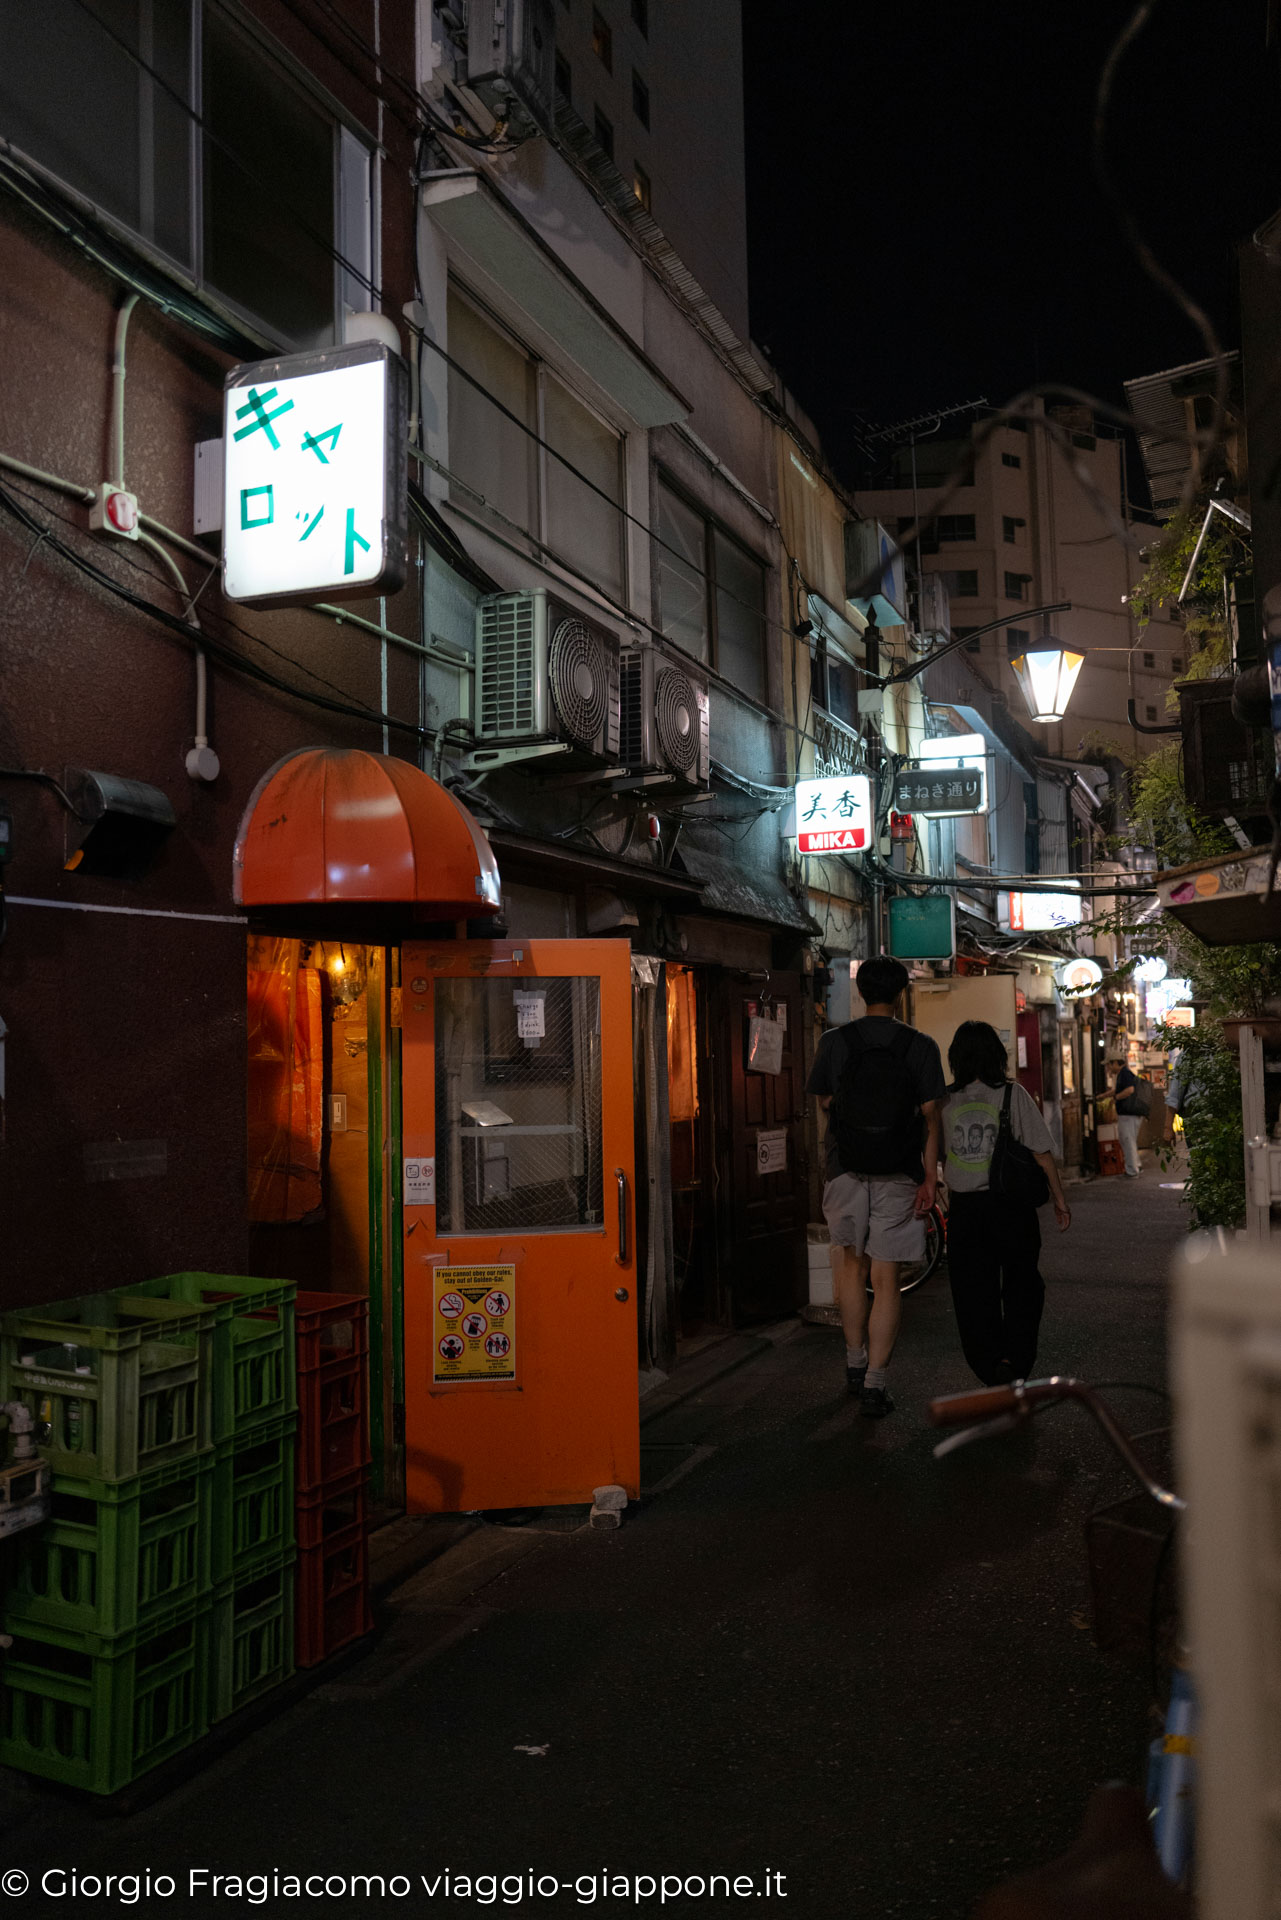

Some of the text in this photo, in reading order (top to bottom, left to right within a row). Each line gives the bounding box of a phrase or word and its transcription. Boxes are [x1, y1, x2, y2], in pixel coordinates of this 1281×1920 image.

[240, 484, 371, 576] ロット
[898, 781, 978, 800] まねき通り
[802, 790, 862, 822] 美香
[808, 831, 857, 850] MIKA
[467, 1276, 473, 1284] of
[472, 1269, 486, 1277] obey
